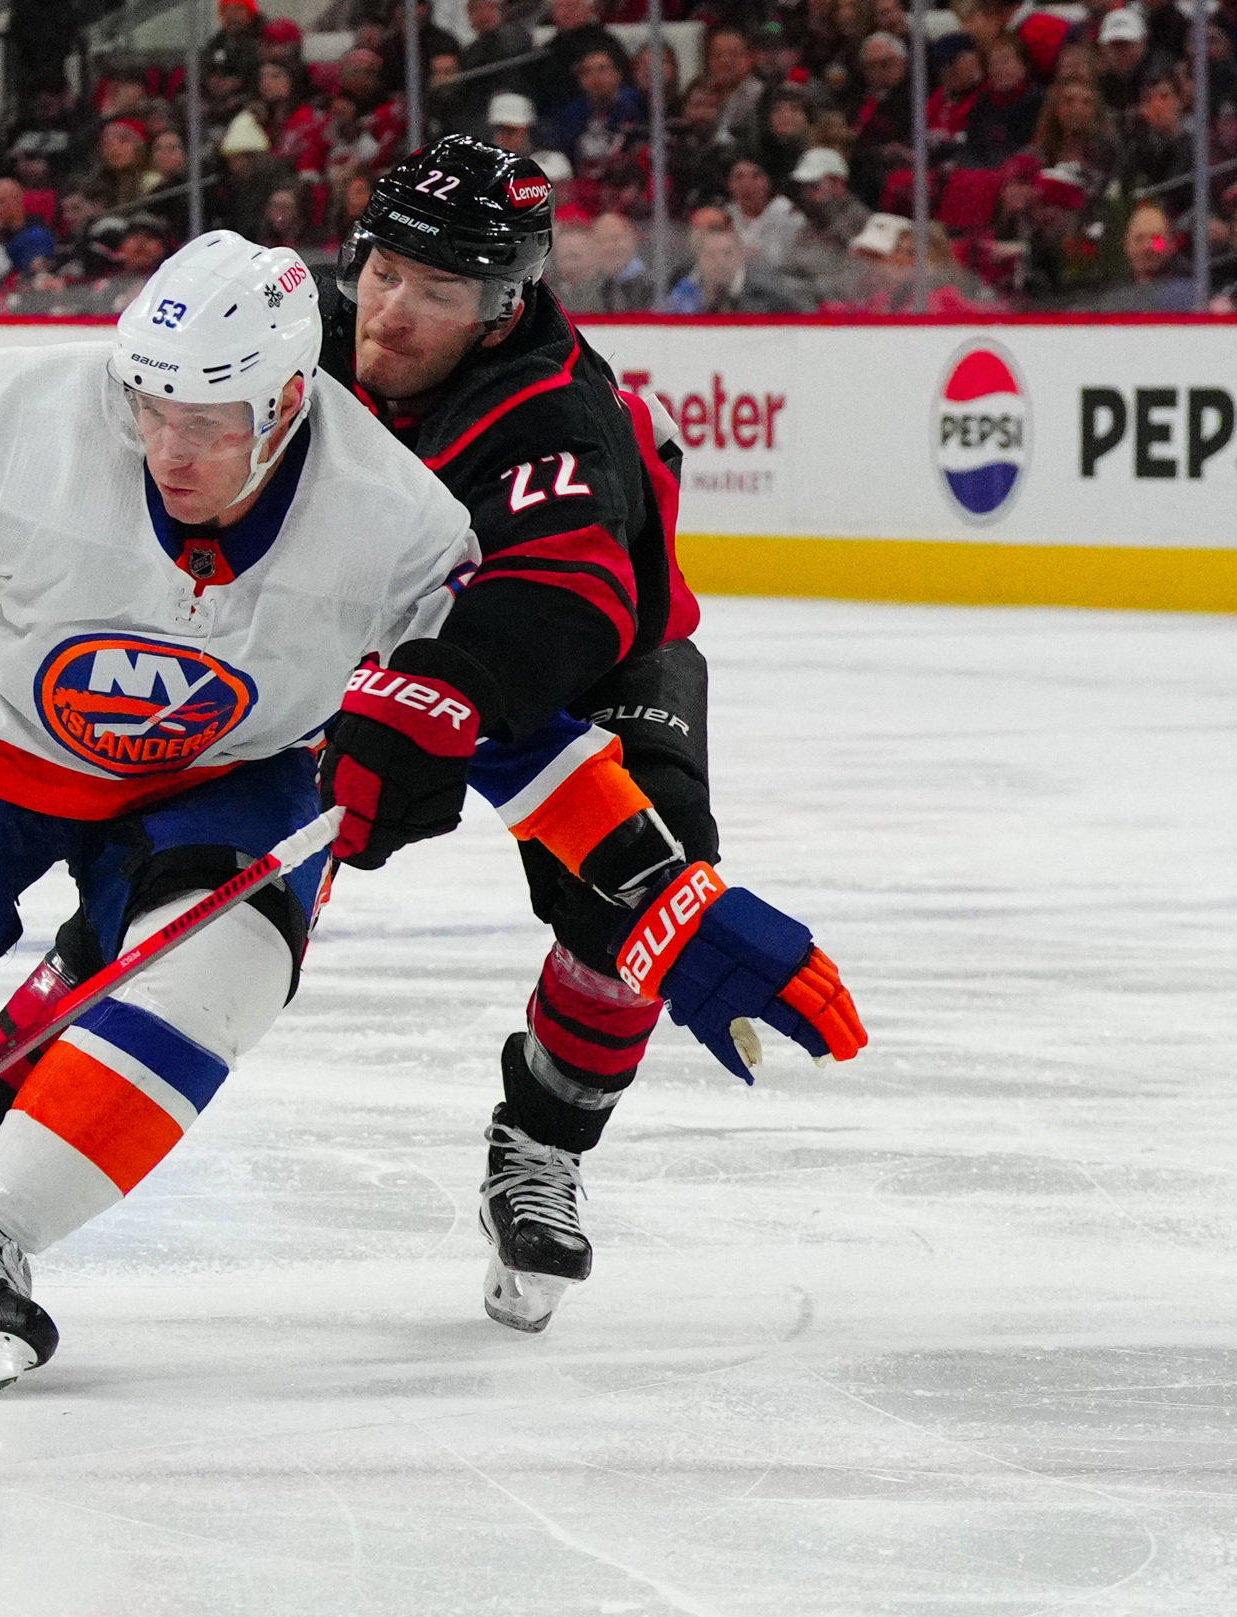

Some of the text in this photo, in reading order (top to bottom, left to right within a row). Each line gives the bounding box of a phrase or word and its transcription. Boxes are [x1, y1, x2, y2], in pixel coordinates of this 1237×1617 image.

[415, 169, 461, 201] 22
[512, 184, 549, 202] Lenovo
[388, 210, 440, 236] BAUER
[277, 262, 307, 294] UBS
[152, 299, 187, 329] 53
[130, 353, 180, 373] BAUER
[621, 370, 786, 450] Teter
[939, 412, 1024, 449] PEPSI
[1079, 385, 1237, 479] PEP
[500, 450, 593, 515] 22
[88, 648, 216, 706] NY
[343, 668, 472, 731] AUER
[61, 708, 219, 762] ISLANDERS
[589, 705, 690, 737] AUER
[619, 869, 718, 995] BAUER
